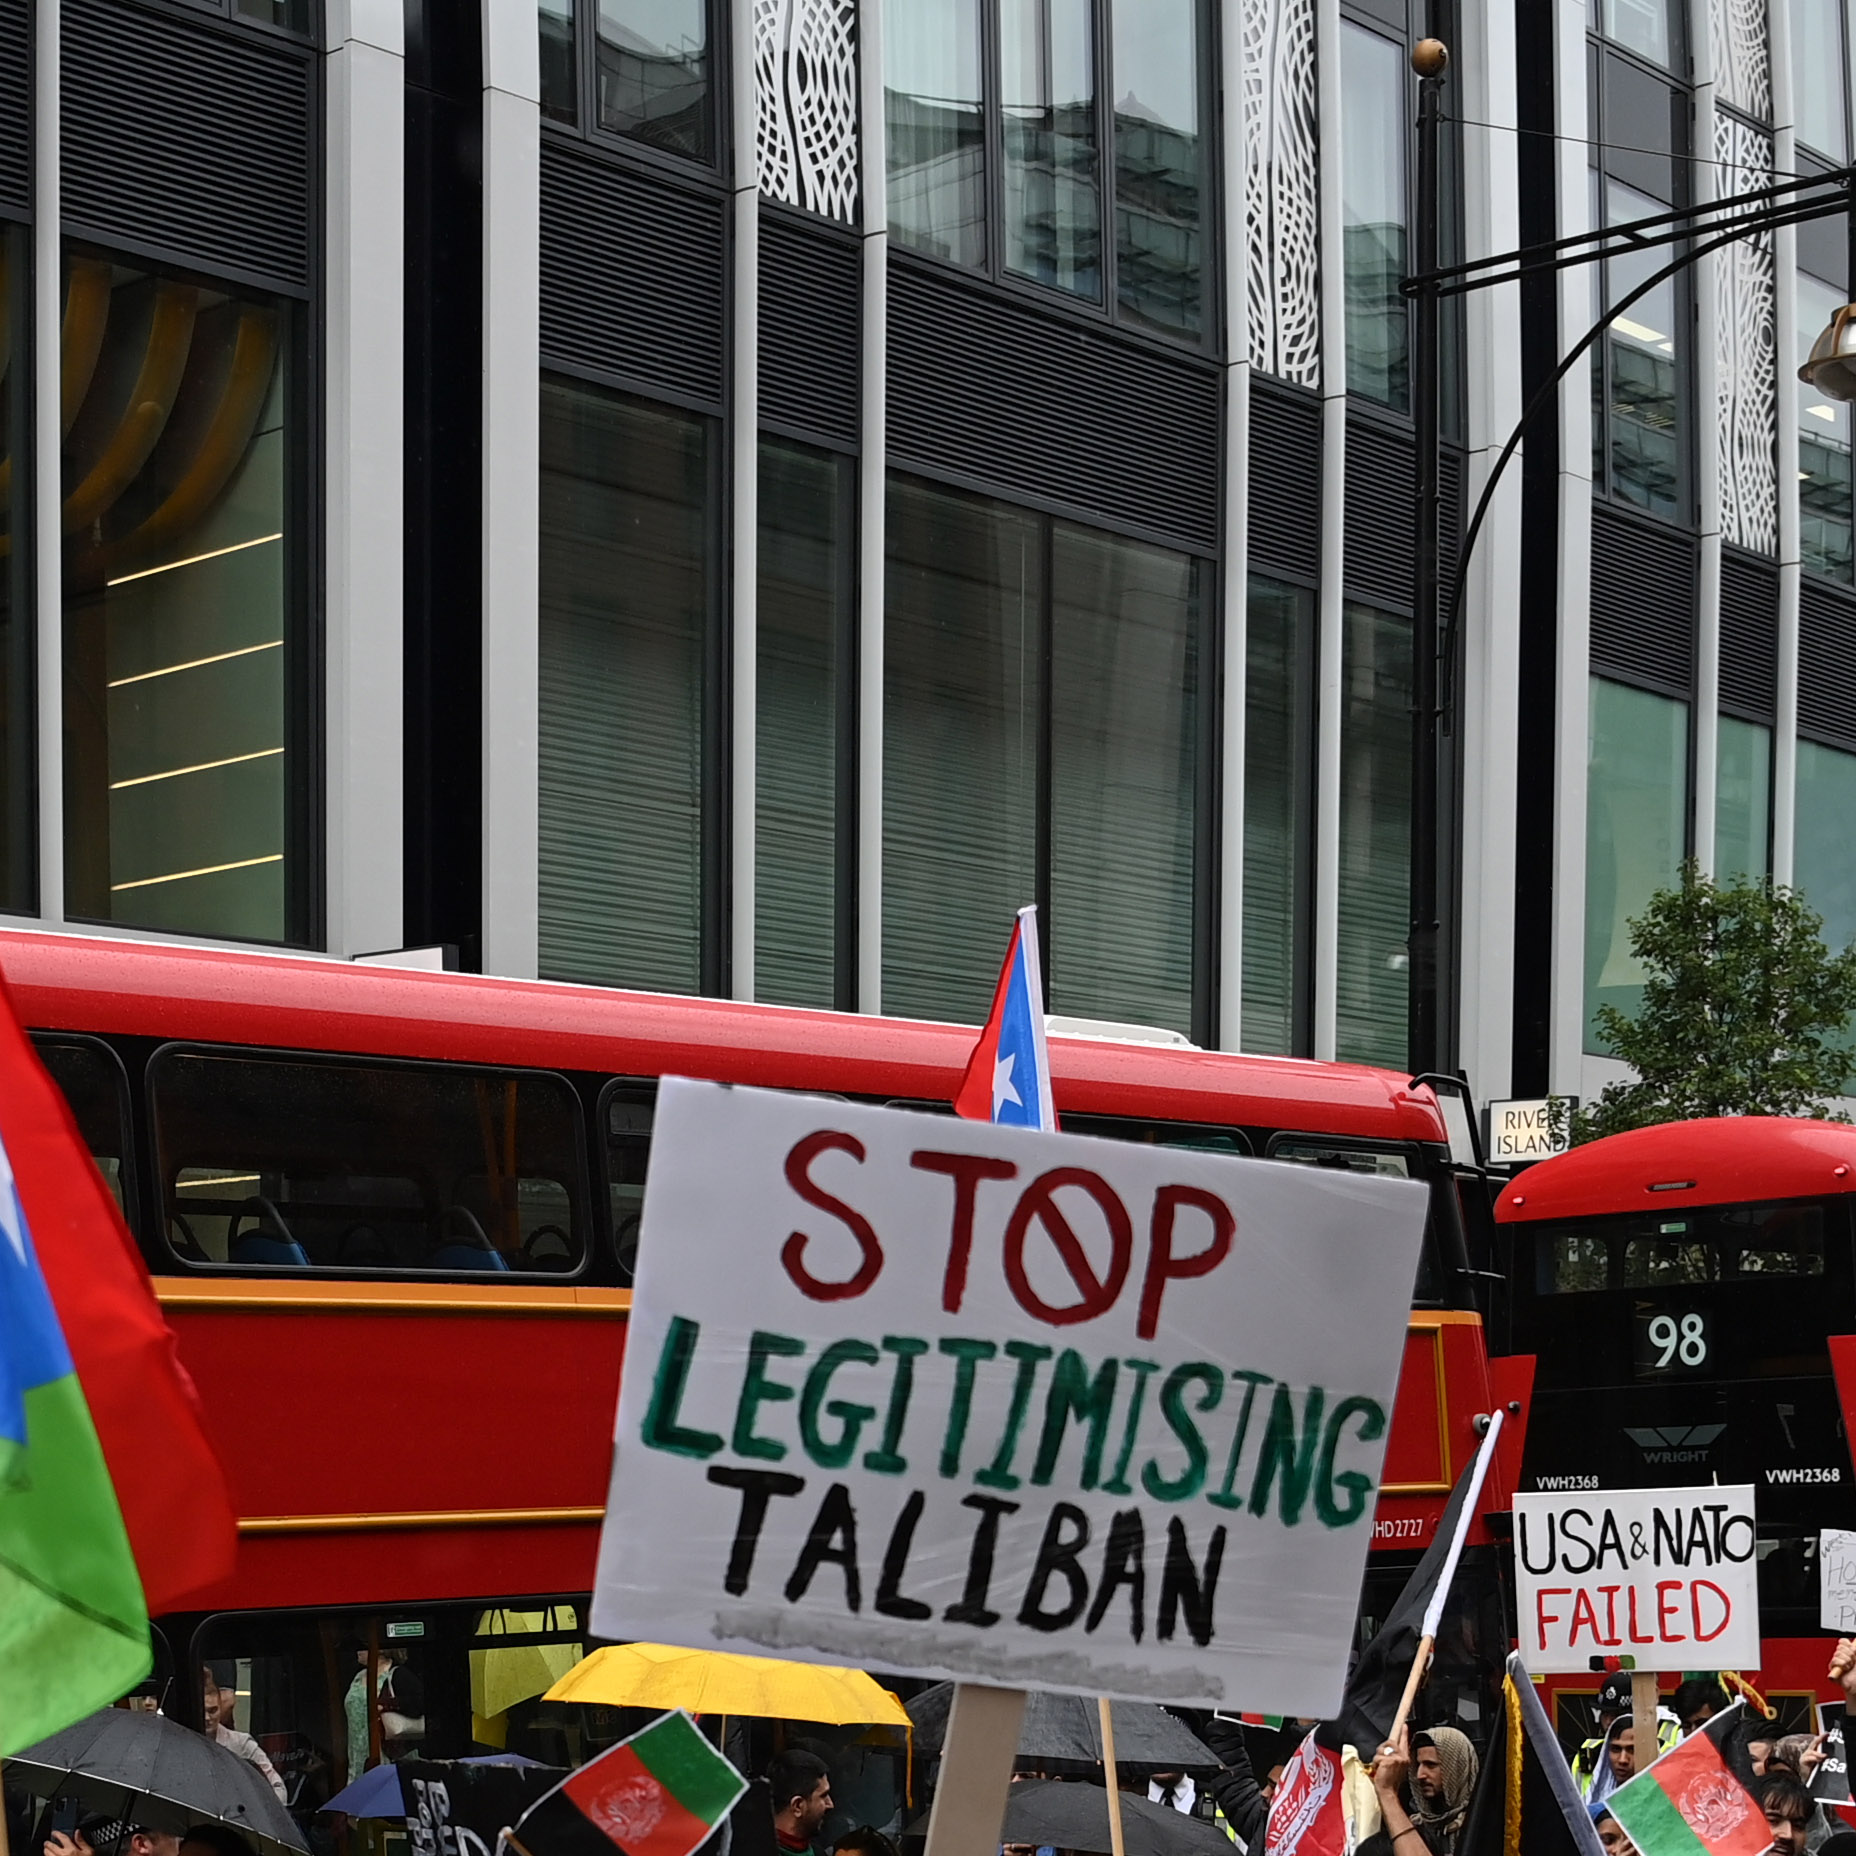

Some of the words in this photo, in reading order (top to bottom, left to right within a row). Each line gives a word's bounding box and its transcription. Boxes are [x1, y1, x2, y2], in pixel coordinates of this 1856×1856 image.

[1497, 1134, 1566, 1155] ISLAND
[780, 1130, 1236, 1339] STOP
[1648, 1313, 1707, 1368] 98
[642, 1316, 1385, 1528] LEGITIMISING
[1536, 1476, 1599, 1490] VWH2368
[1643, 1451, 1708, 1464] WRIGHT
[1765, 1469, 1840, 1484] VWH2368
[706, 1464, 1226, 1648] TALIBAN
[1537, 1580, 1731, 1651] FAILED
